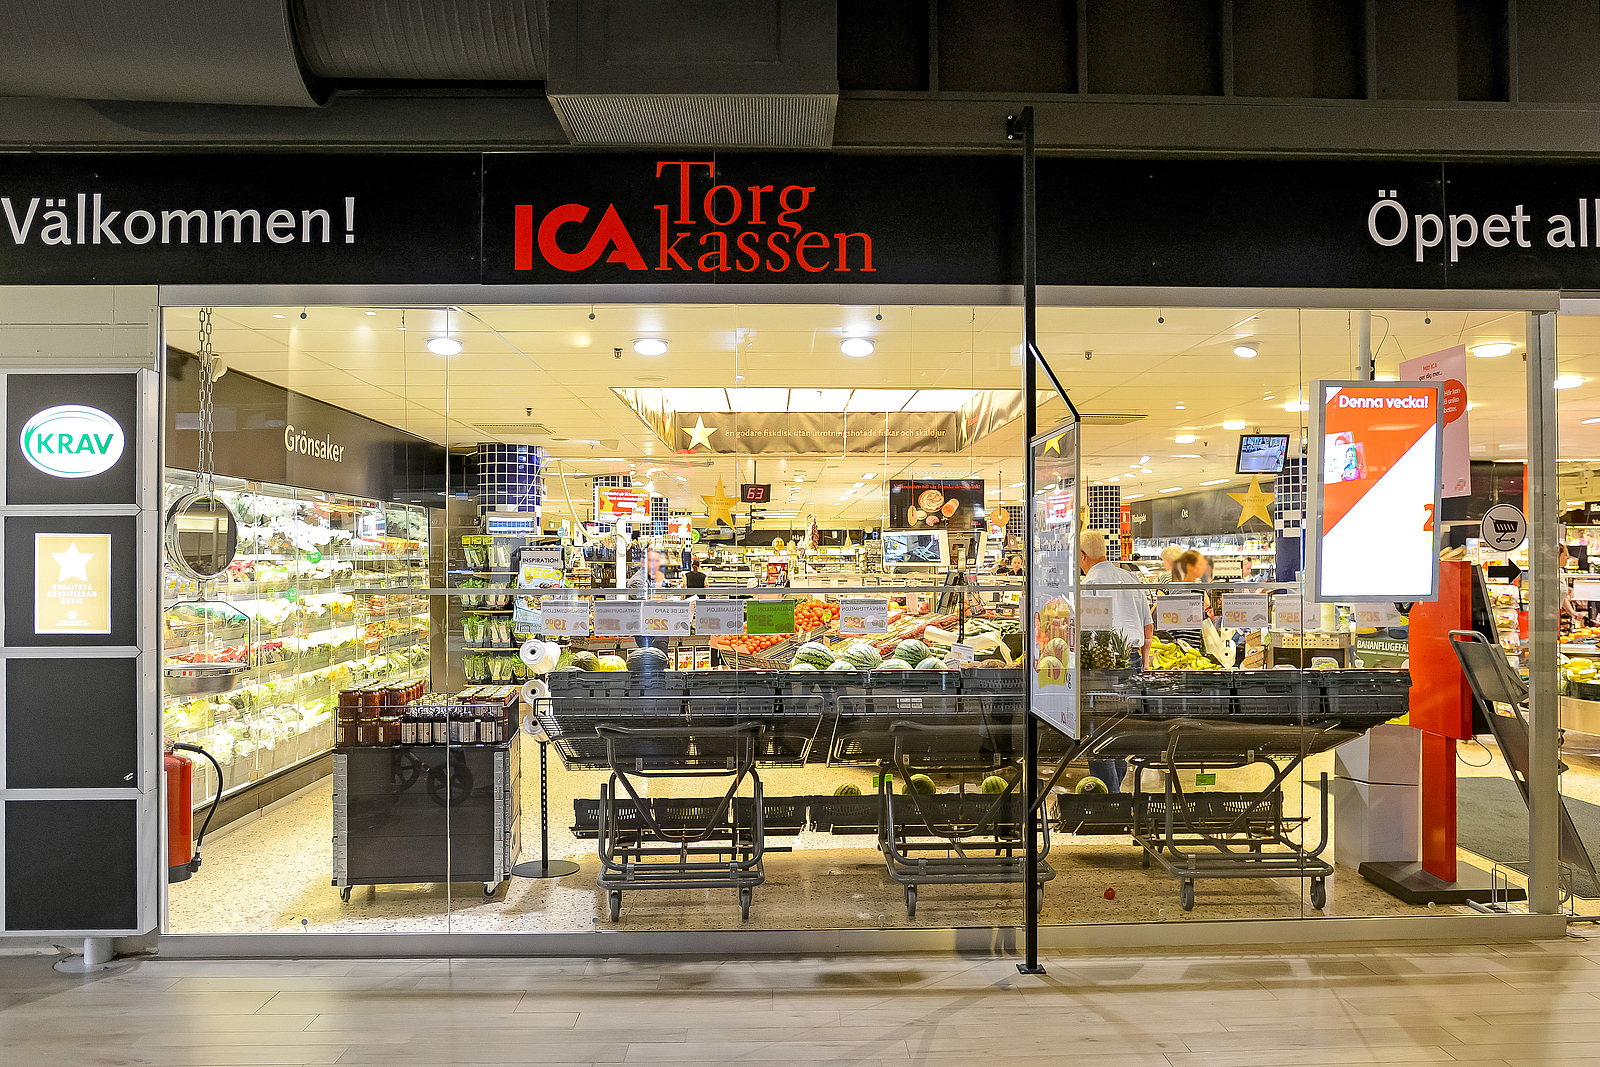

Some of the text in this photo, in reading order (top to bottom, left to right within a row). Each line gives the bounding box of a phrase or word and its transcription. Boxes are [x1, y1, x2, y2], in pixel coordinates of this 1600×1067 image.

[655, 162, 816, 235] Torg
[1, 193, 355, 246] Välkommen!
[1368, 190, 1532, 266] Öppet
[514, 203, 648, 272] ICA
[654, 204, 877, 273] kassen
[1339, 395, 1428, 408] Denna vecka!
[37, 433, 114, 455] KRAV
[284, 424, 345, 463] Grönsaker
[725, 429, 735, 437] En
[736, 429, 762, 439] godare
[763, 429, 792, 437] fiskdisk
[900, 429, 914, 437] och
[915, 429, 946, 439] skaldjur
[747, 487, 764, 499] 63
[1423, 503, 1434, 531] 2
[524, 567, 563, 580] VEGO
